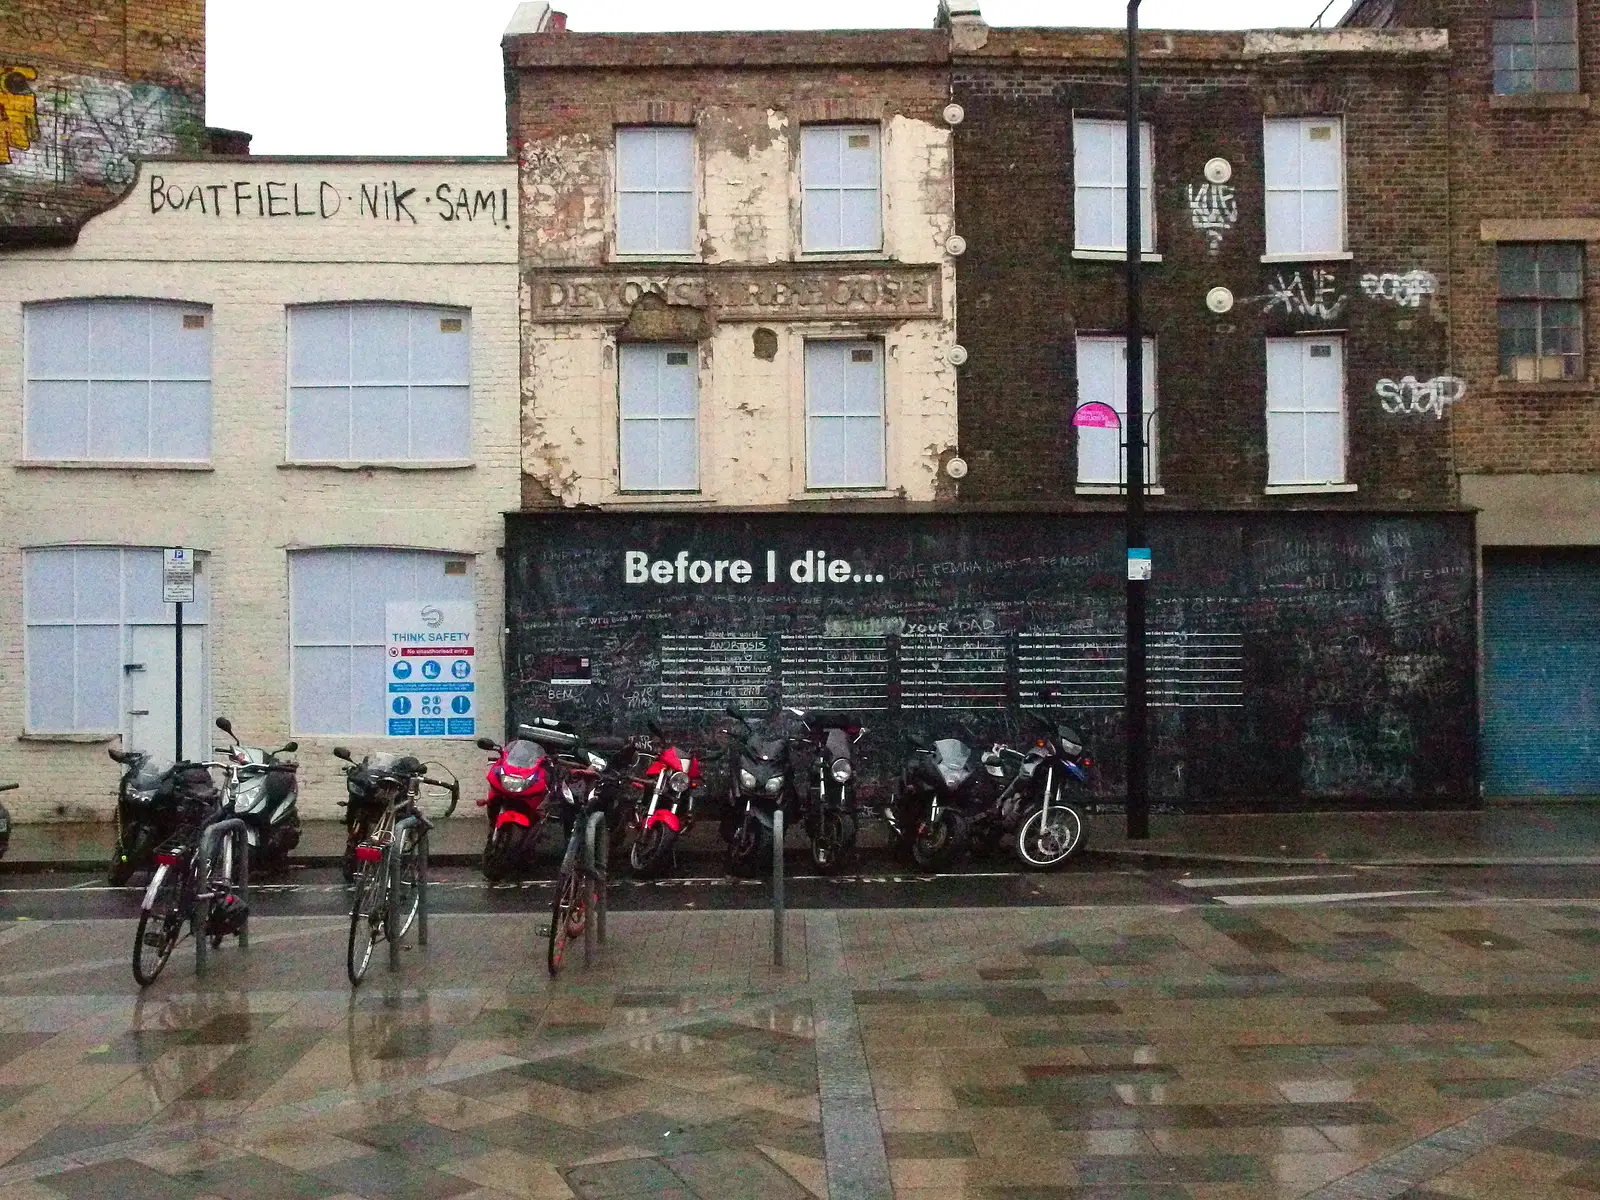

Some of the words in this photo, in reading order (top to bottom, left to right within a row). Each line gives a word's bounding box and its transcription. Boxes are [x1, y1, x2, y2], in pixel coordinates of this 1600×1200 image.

[150, 175, 341, 218] BOATFIELD
[625, 551, 752, 584] Before
[768, 551, 776, 583] I
[790, 550, 884, 584] die...
[392, 633, 425, 642] THINK
[428, 632, 470, 642] SAFETY
[907, 621, 949, 633] YOUR
